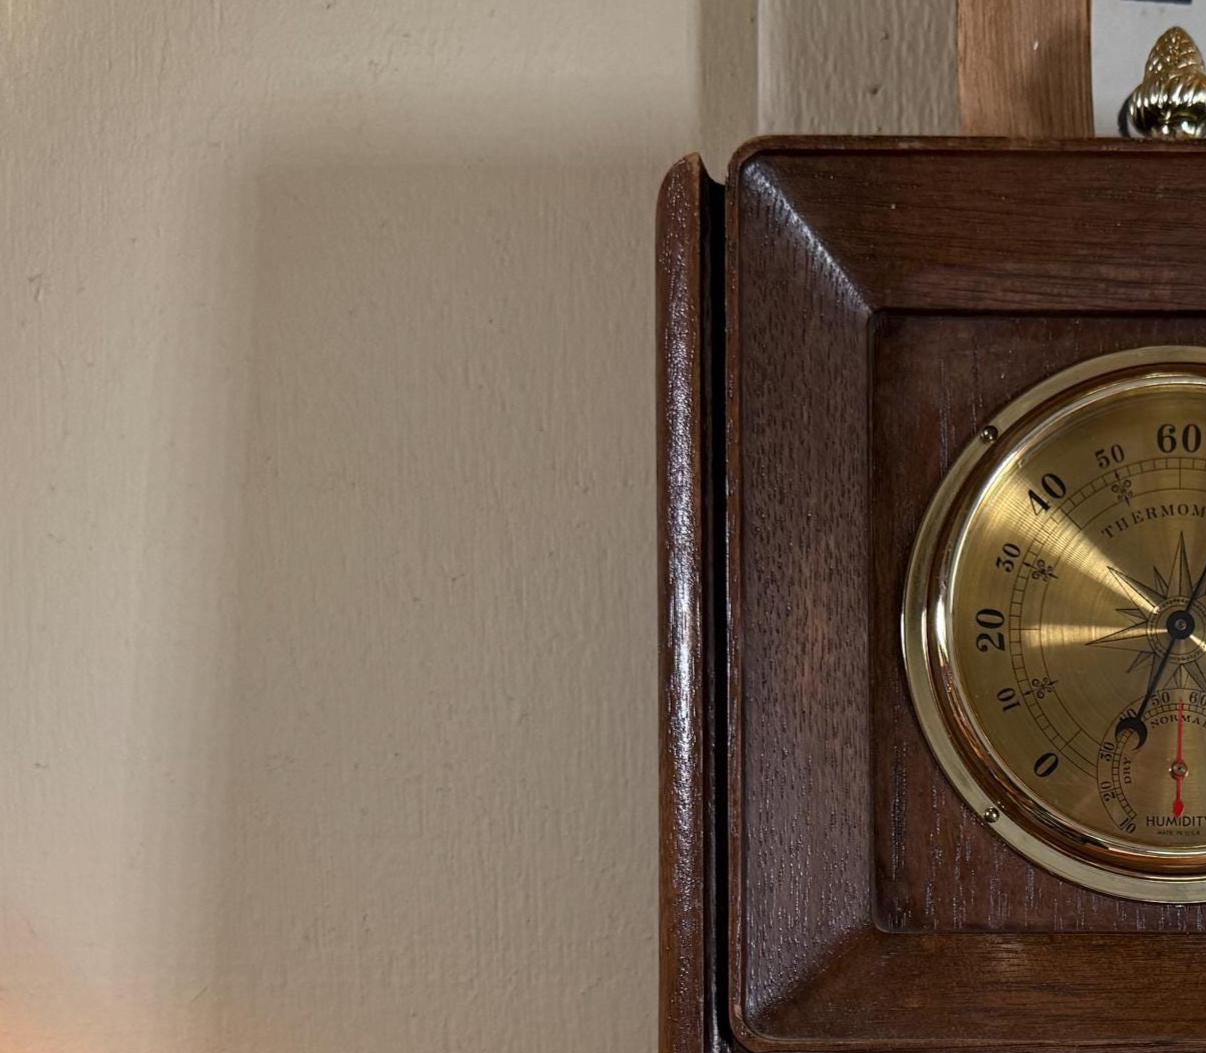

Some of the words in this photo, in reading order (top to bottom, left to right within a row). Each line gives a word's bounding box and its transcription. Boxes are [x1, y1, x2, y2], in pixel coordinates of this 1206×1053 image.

[1157, 424, 1201, 453] 60
[1095, 444, 1125, 469] 50
[1028, 473, 1067, 517] 40
[996, 543, 1021, 573] 30
[976, 608, 1005, 652] 20
[997, 688, 1021, 712] 10
[1151, 692, 1171, 705] 50
[1033, 752, 1059, 778] 0
[1123, 756, 1132, 784] DRY
[1101, 781, 1116, 801] 20
[1119, 817, 1136, 834] 10
